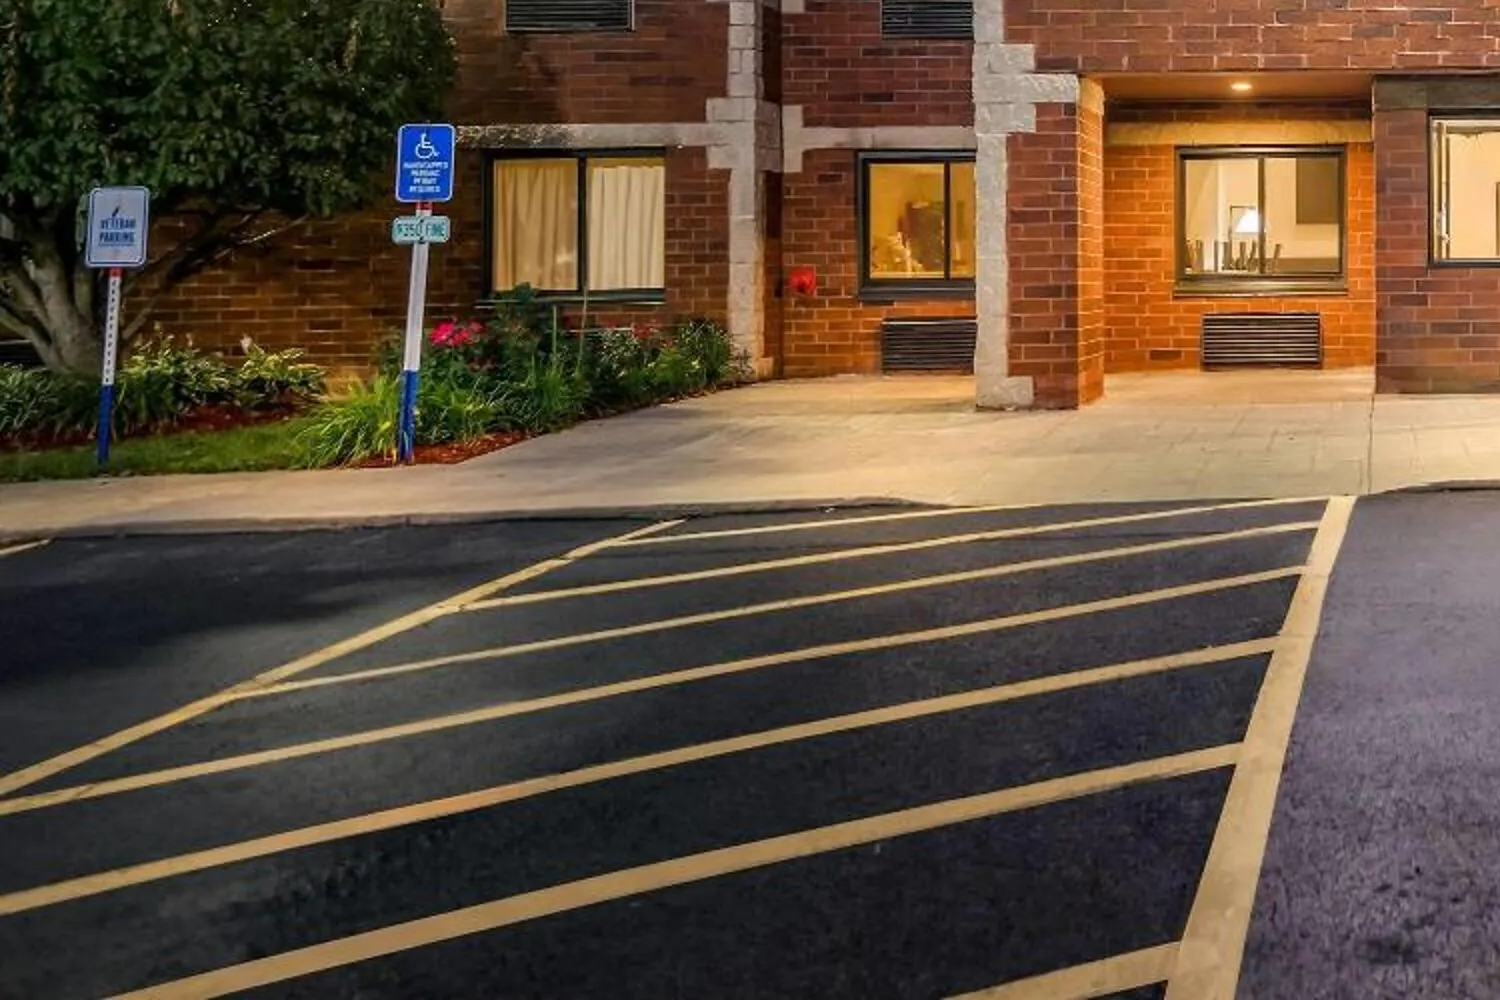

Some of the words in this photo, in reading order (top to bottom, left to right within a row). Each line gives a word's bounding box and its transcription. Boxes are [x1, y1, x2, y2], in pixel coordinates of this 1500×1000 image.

[100, 218, 137, 230] VETERAN
[426, 222, 446, 238] FINE
[99, 231, 136, 243] PARKING
